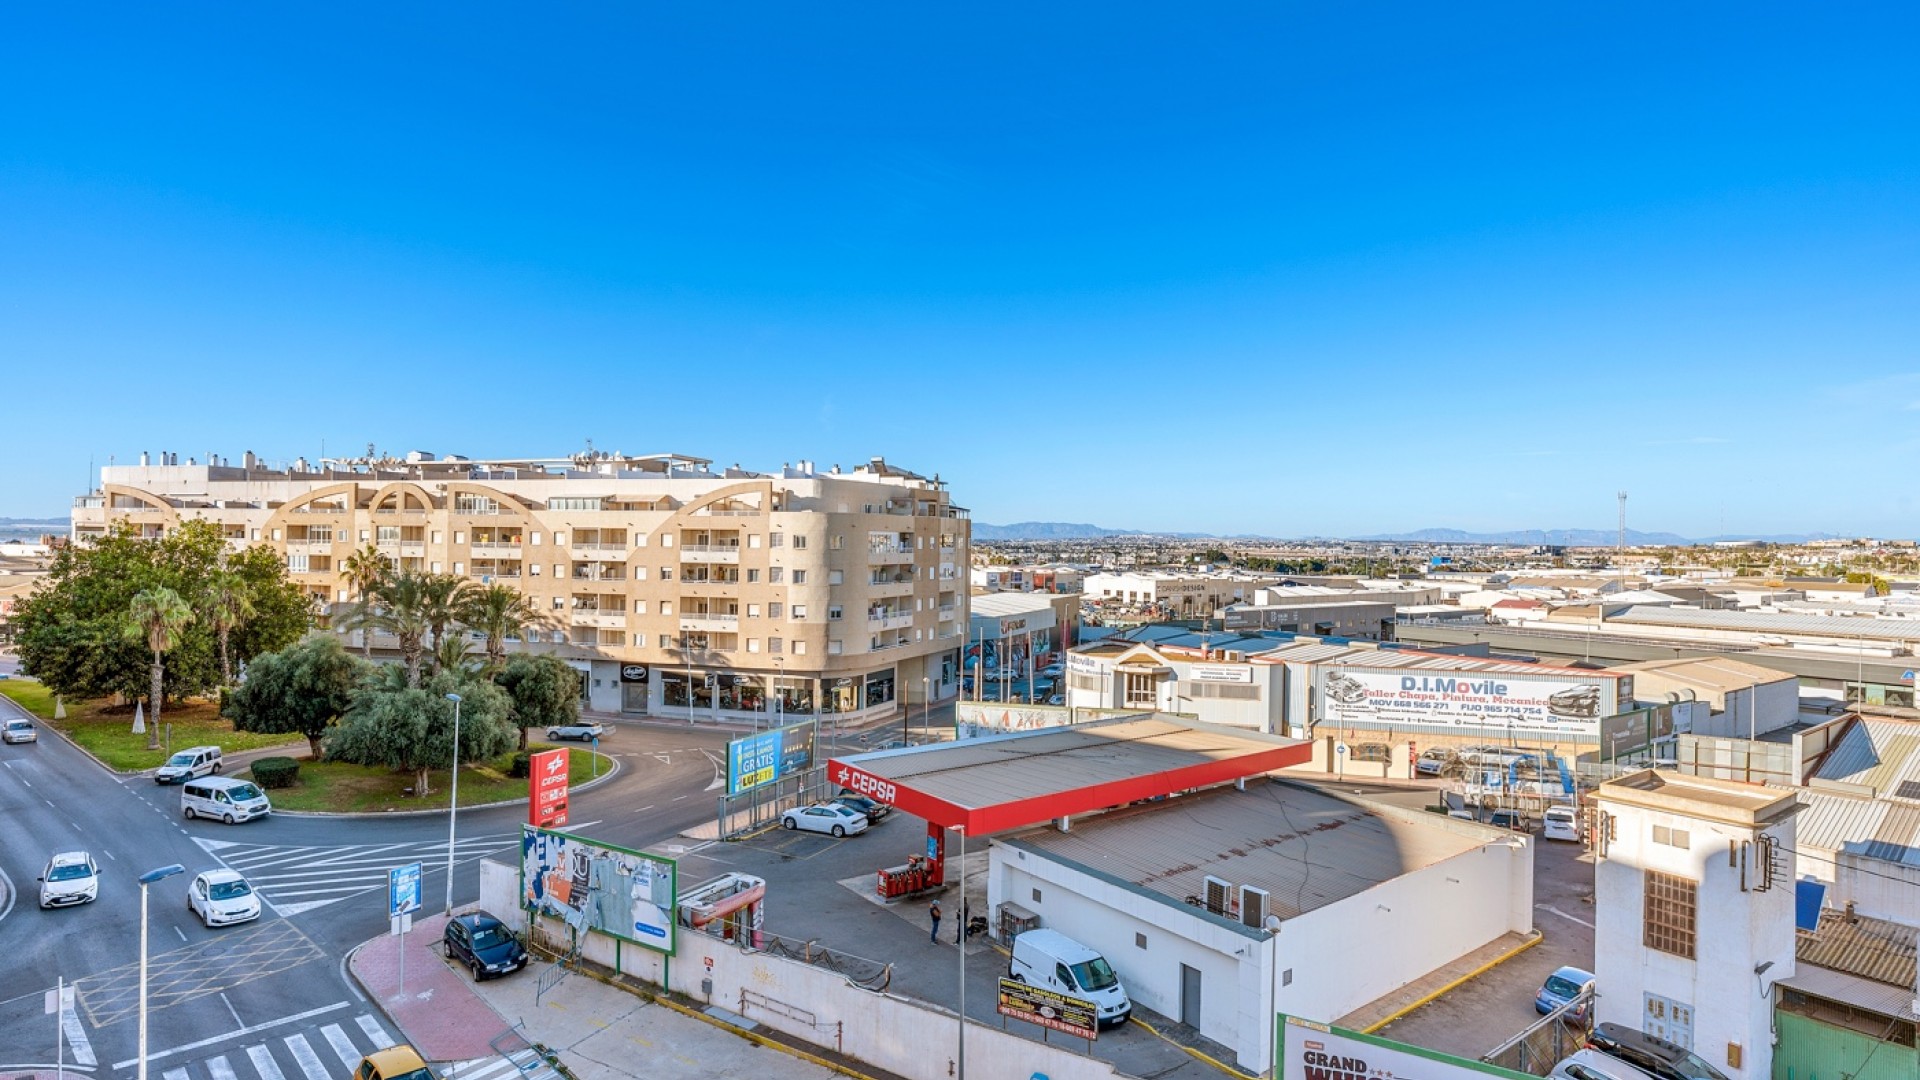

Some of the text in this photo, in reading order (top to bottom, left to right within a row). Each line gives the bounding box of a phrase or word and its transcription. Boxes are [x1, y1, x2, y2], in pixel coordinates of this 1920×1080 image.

[1362, 688, 1396, 699] Taller
[1401, 675, 1508, 696] D.I.Movile
[1369, 699, 1393, 707] MOV
[1461, 703, 1482, 711] FIJO
[1504, 706, 1521, 714] 714
[1523, 707, 1542, 715] 754
[742, 752, 774, 773] GRATIS
[851, 771, 897, 804] CEPSA
[1303, 1051, 1367, 1073] GRAND
